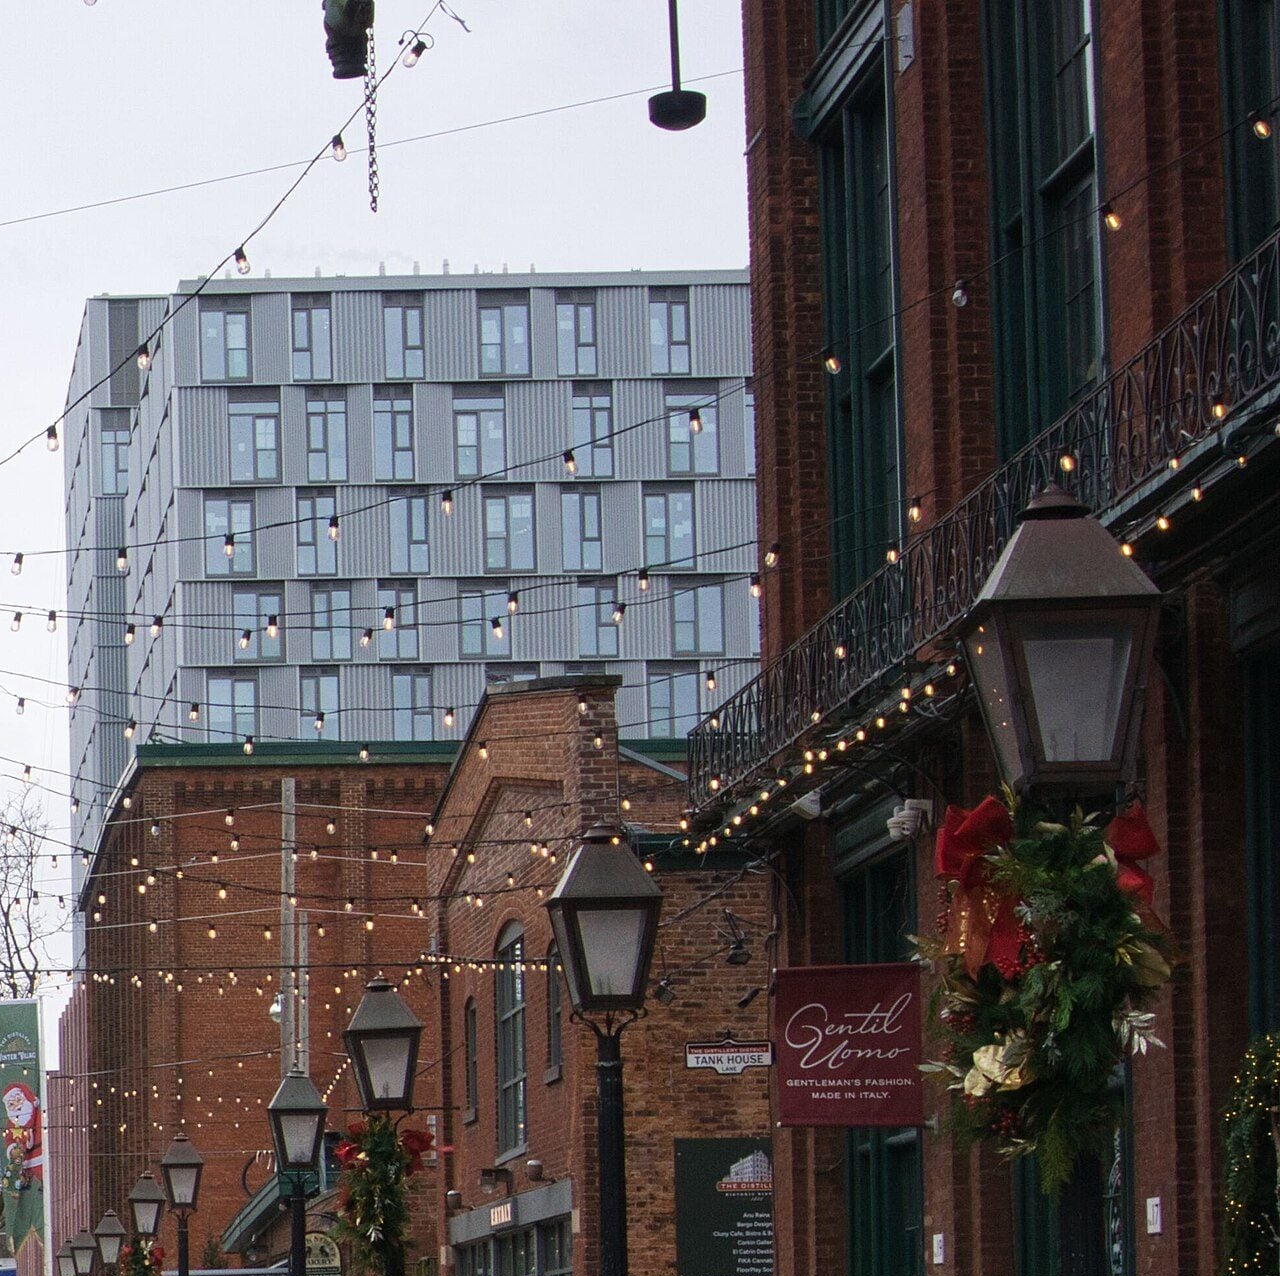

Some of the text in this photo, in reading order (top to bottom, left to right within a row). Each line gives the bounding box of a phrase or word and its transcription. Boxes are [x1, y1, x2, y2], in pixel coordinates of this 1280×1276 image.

[785, 993, 912, 1048] Gentil
[695, 1054, 763, 1065] TANK HOUSE
[800, 1025, 910, 1069] Uomo
